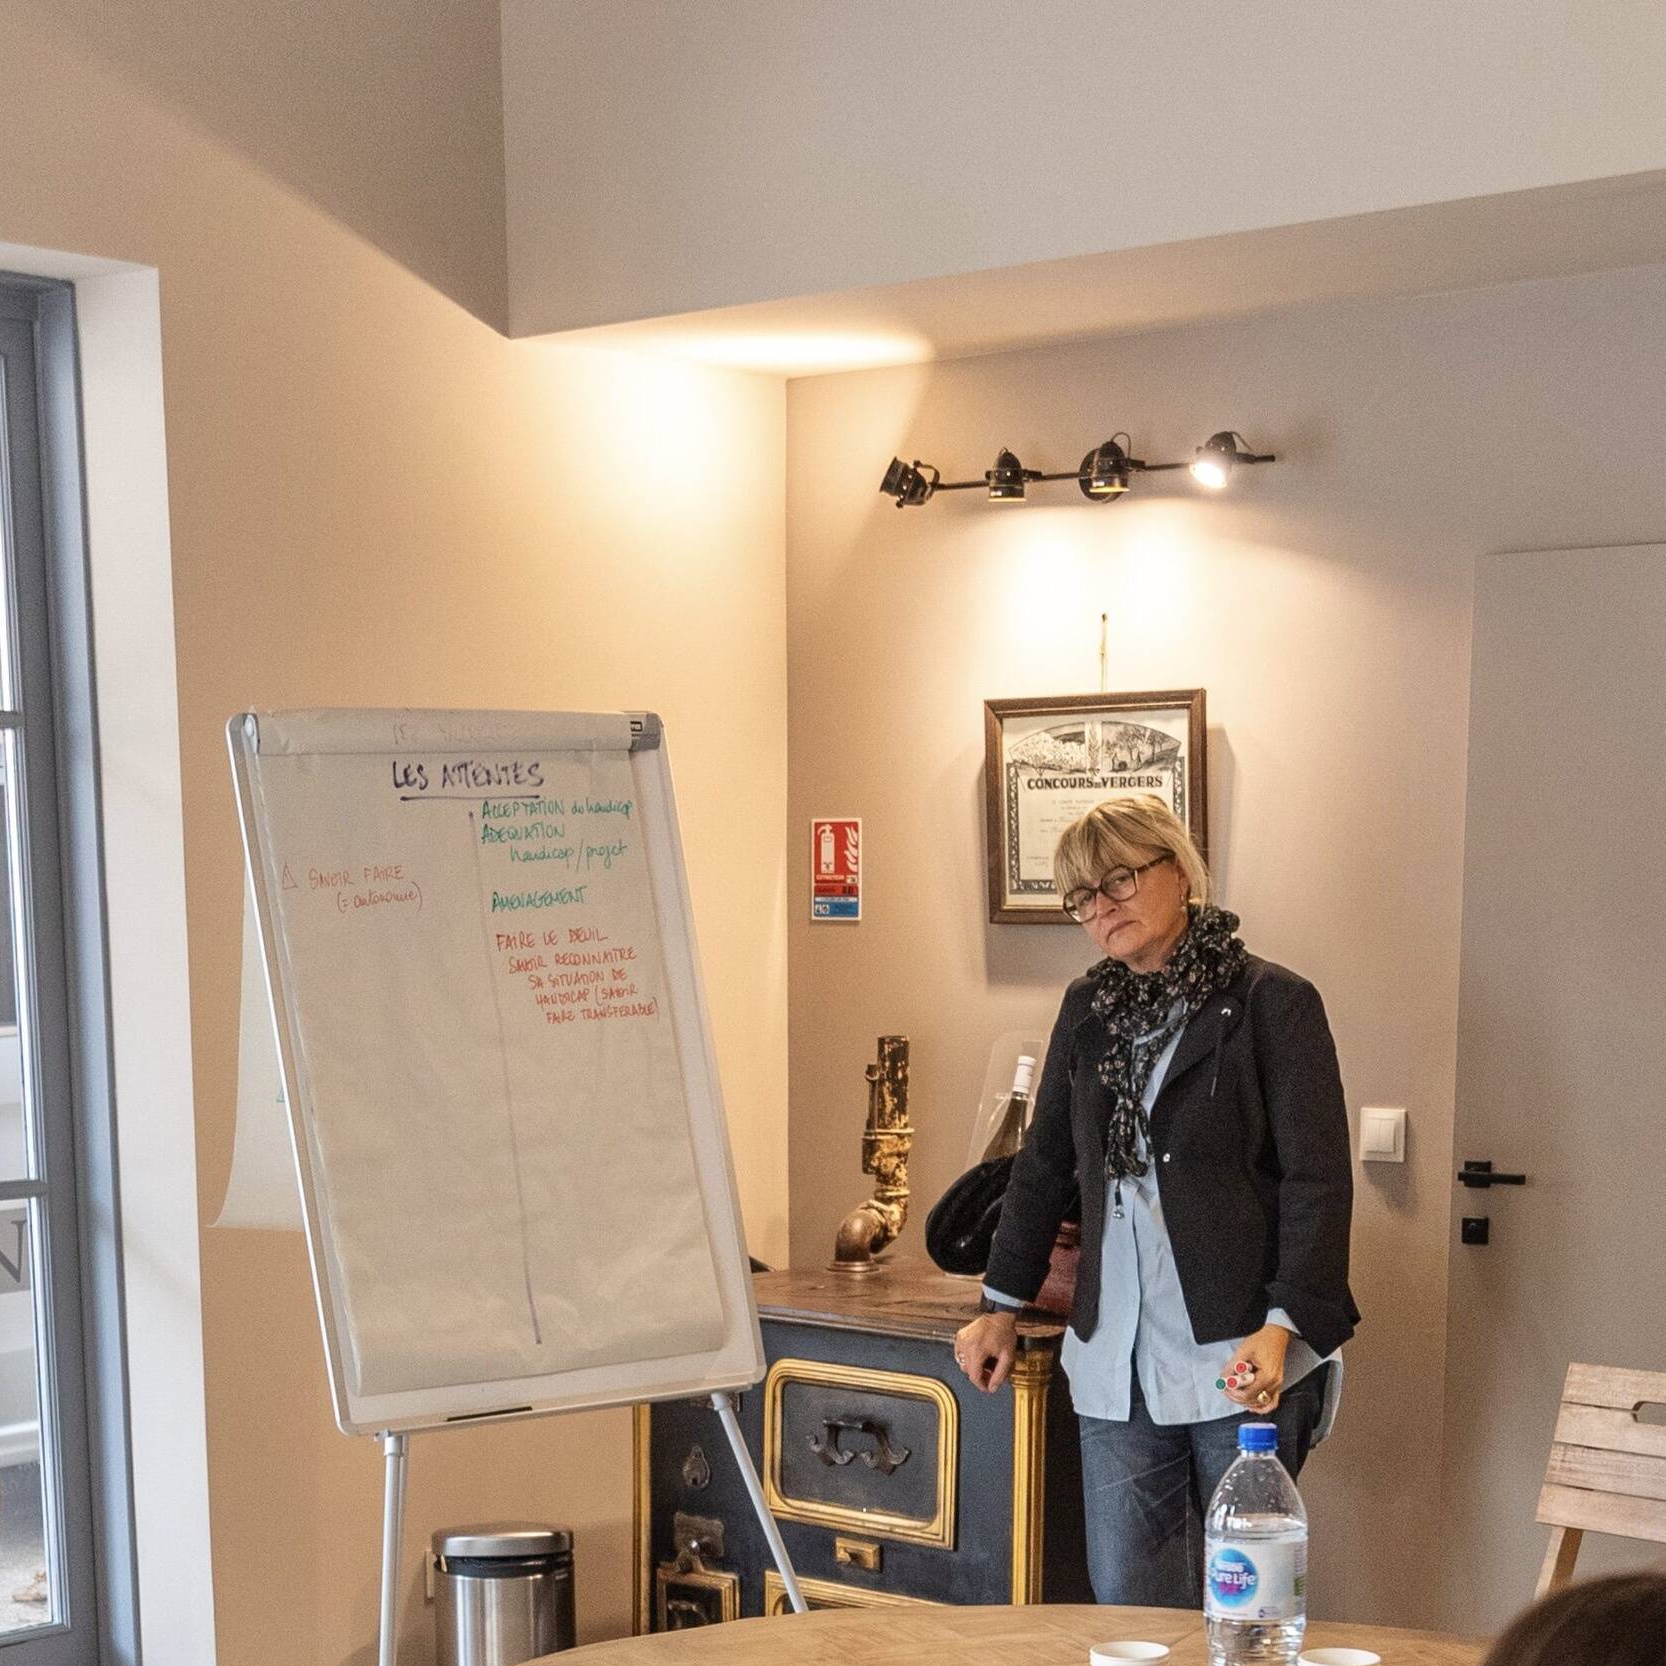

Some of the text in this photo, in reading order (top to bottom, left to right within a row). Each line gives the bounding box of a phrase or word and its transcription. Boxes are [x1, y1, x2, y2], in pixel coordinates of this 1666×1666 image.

[392, 760, 544, 790] LES ATTENTES
[1027, 777, 1094, 790] CONCOURS
[1100, 775, 1163, 789] VERGERS
[482, 799, 565, 819] ACCEPTATION
[481, 820, 565, 844] ADEQUATION
[309, 865, 404, 889] SAVOIR FAIRE
[492, 885, 587, 912] AMENAGEMENT
[496, 926, 609, 951] FAIRE LE DEUIL
[509, 955, 547, 974] SAVOIR
[528, 967, 627, 990] SA SITUATION DE
[536, 988, 590, 1011] HANDICAP
[546, 1009, 575, 1024] FAIRE
